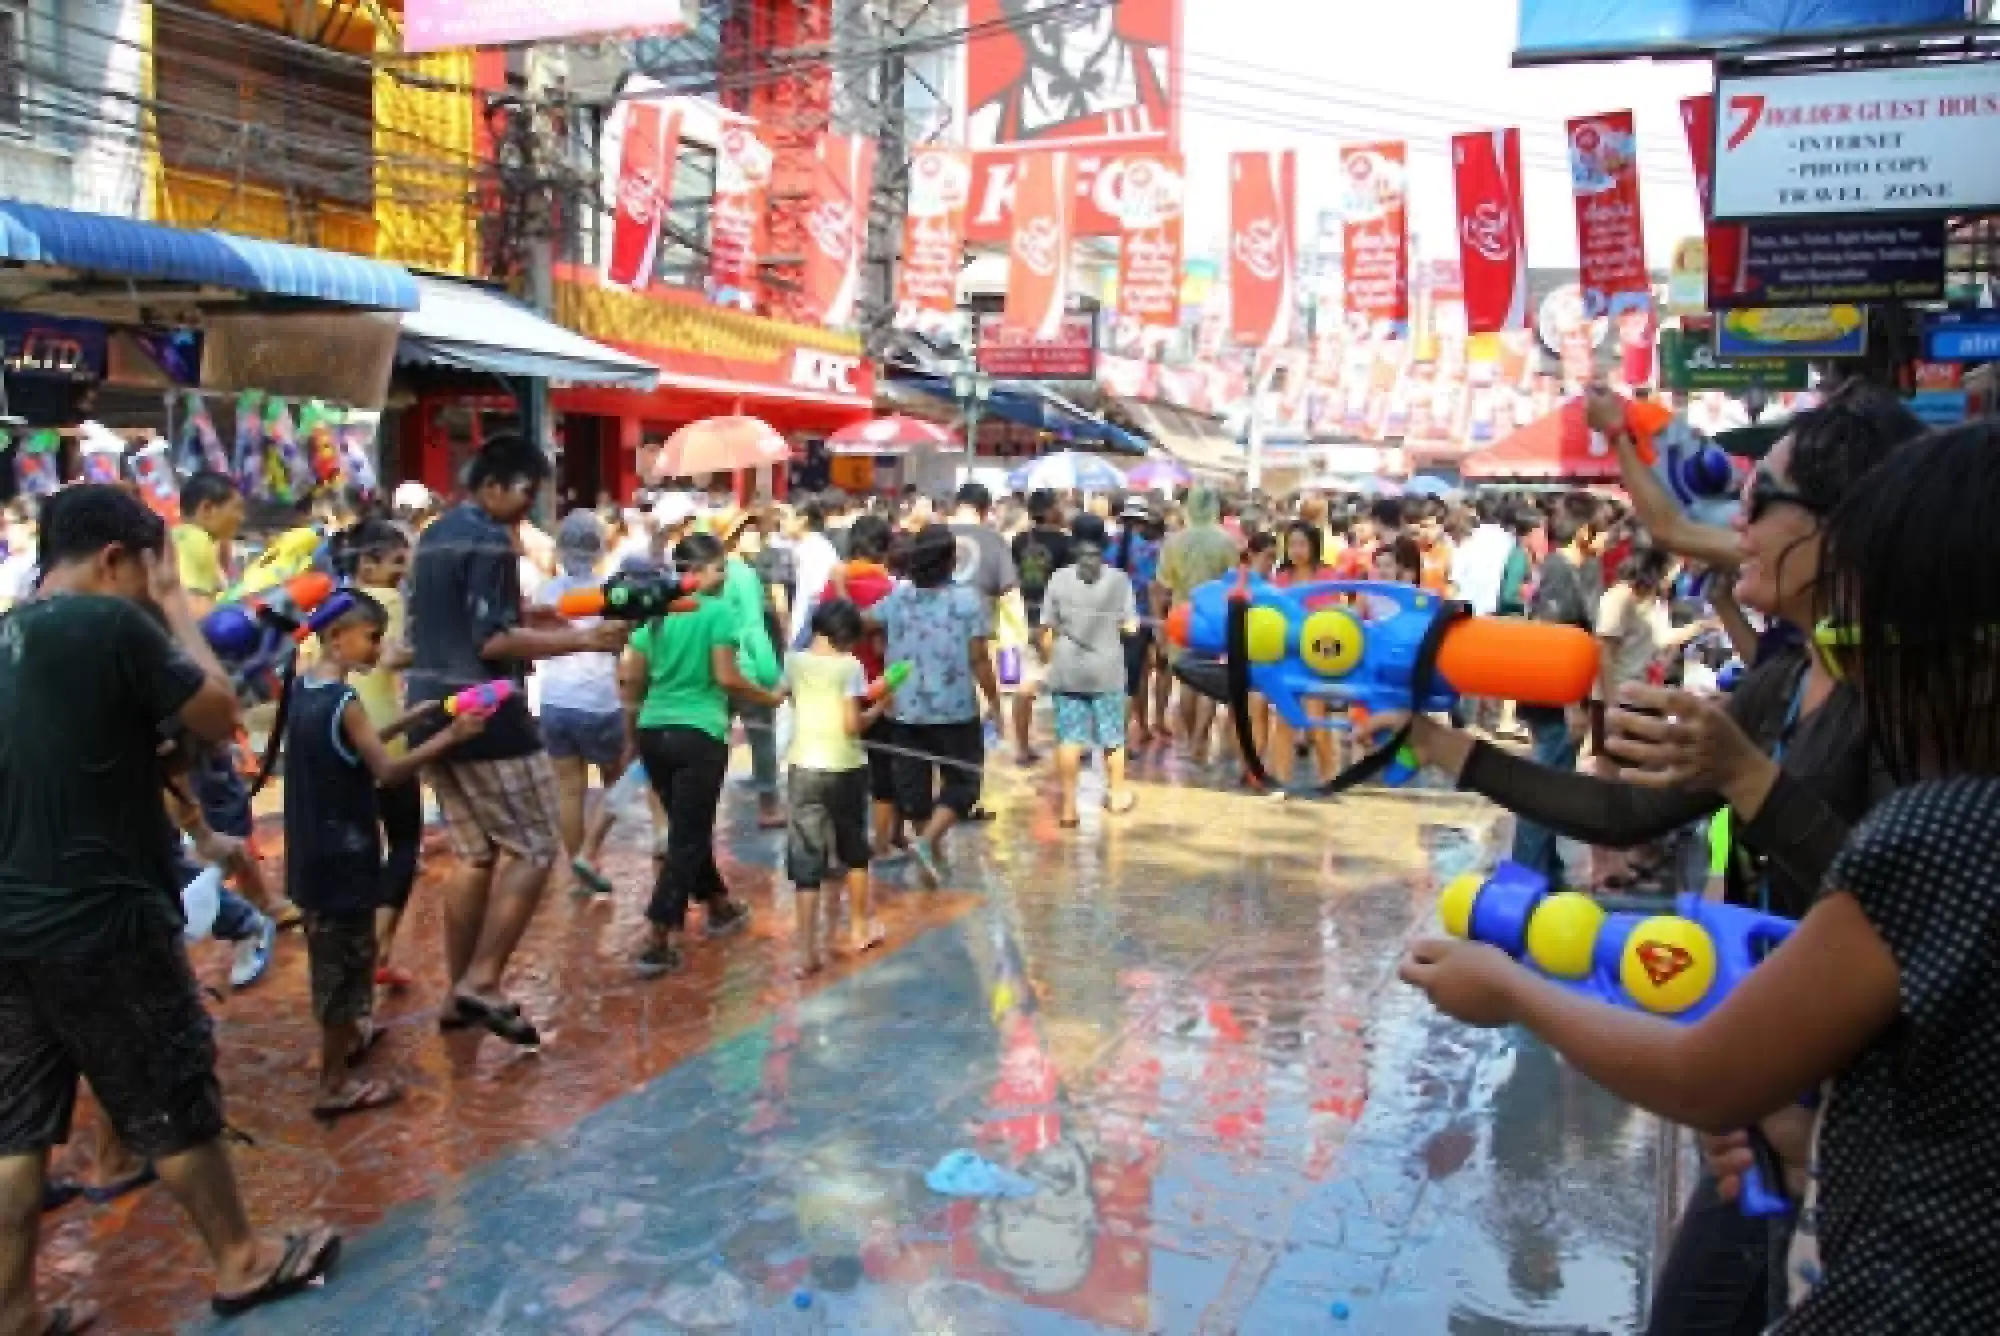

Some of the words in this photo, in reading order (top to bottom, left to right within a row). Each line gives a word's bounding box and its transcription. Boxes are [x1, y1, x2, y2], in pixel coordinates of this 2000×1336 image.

[1766, 104, 1851, 127] HOLDER
[1858, 99, 1928, 122] GUEST
[1875, 155, 1931, 174] COPY
[1778, 187, 1867, 204] TRAVEL
[1883, 182, 1951, 201] ZONE
[791, 348, 861, 393] KFC
